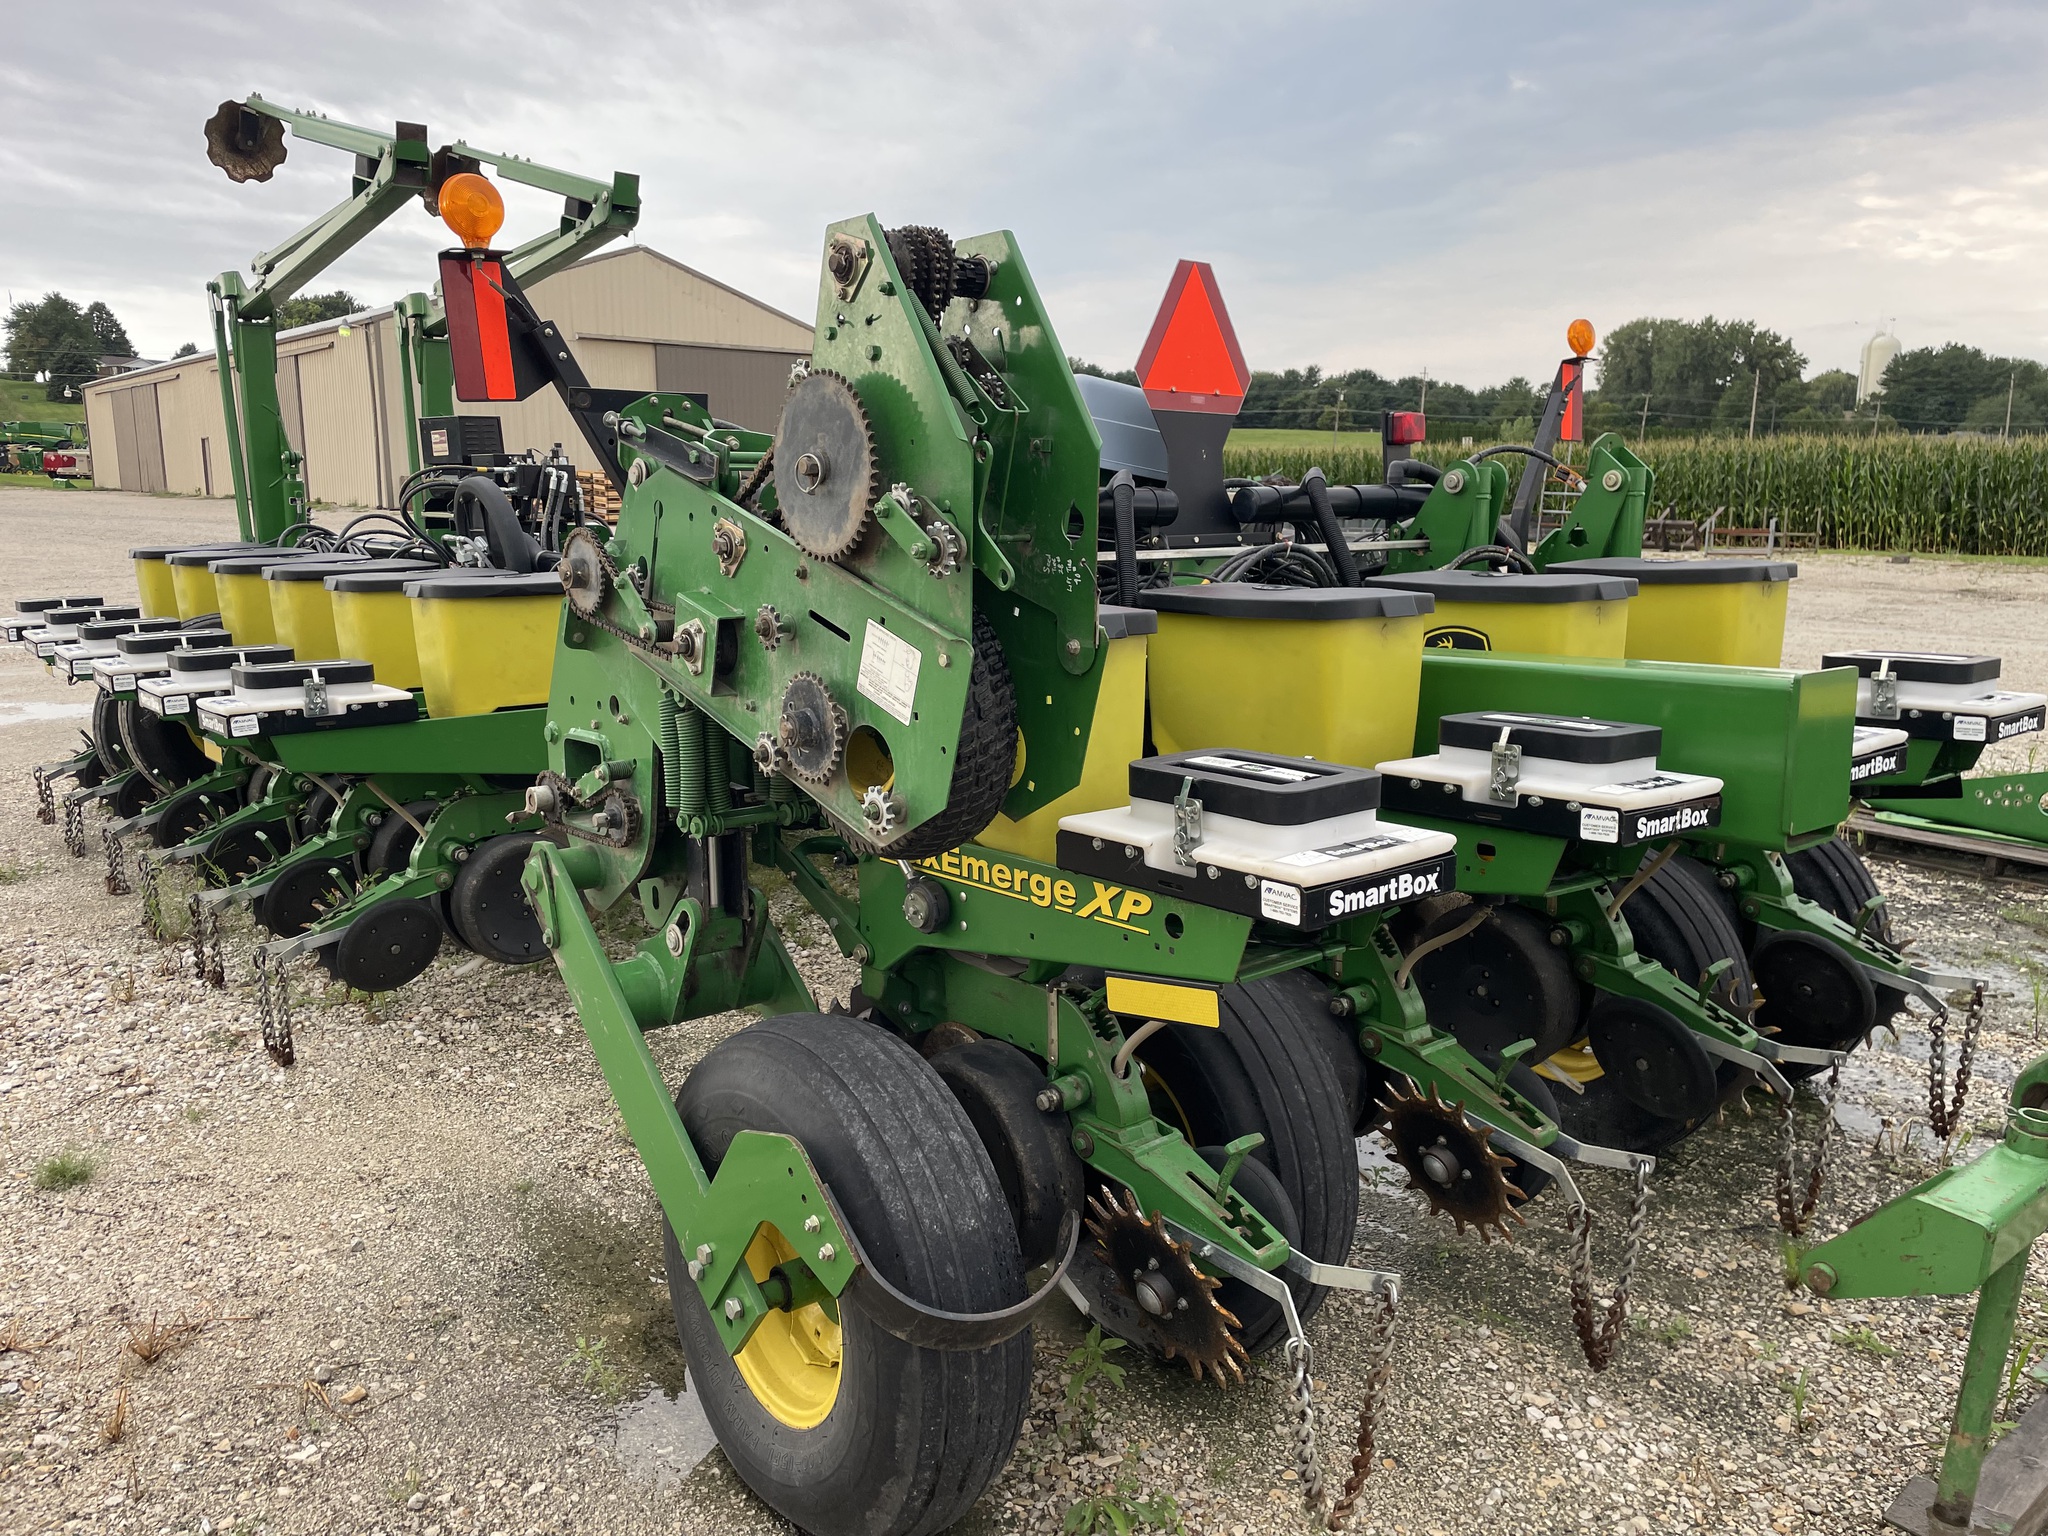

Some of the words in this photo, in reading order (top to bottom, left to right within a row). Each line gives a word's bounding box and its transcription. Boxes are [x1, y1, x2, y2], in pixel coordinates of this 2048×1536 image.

[1998, 715, 2039, 739] SmartBox
[1850, 754, 1897, 781] martBox
[1636, 807, 1710, 839] SmartBox
[909, 847, 1078, 908] xEmerge
[1075, 881, 1153, 922] XP
[1272, 888, 1297, 901] AMVAC
[1328, 870, 1440, 917] SmartBox
